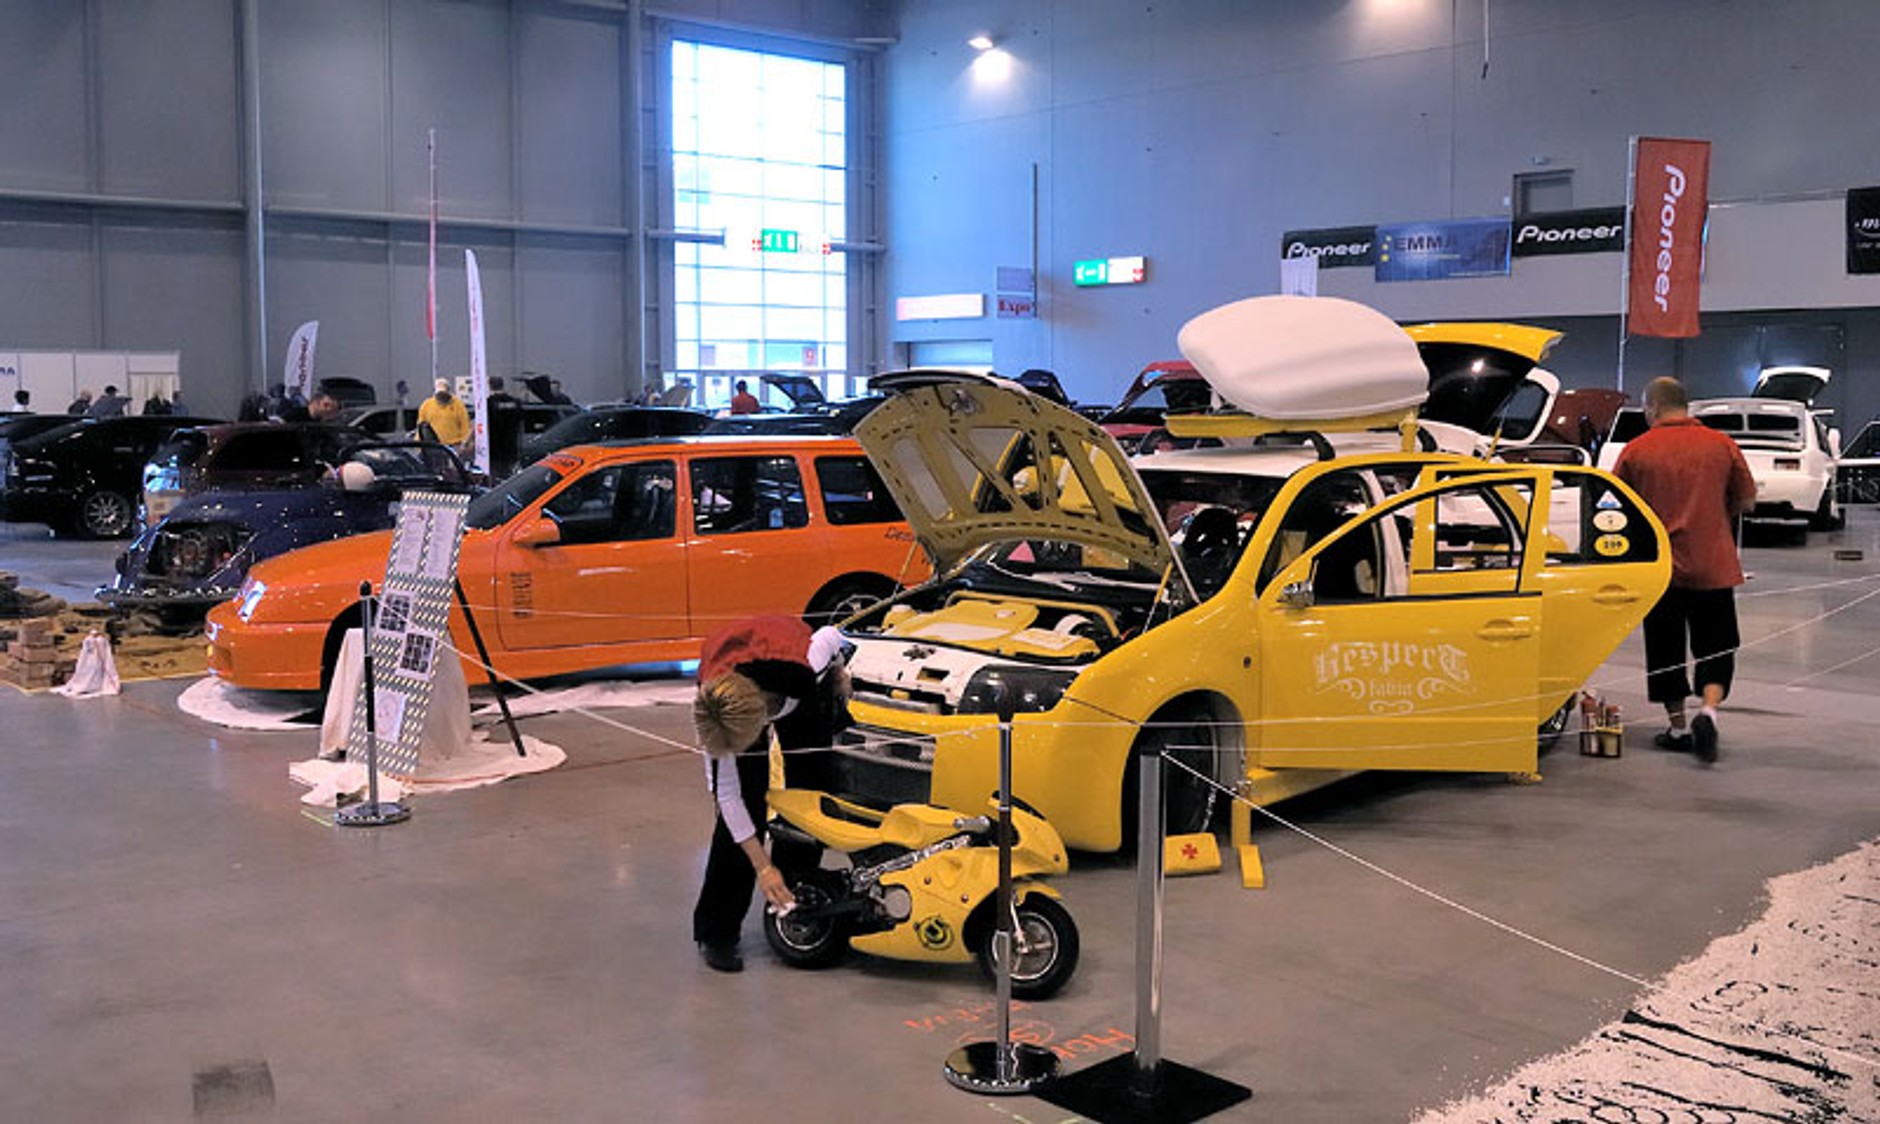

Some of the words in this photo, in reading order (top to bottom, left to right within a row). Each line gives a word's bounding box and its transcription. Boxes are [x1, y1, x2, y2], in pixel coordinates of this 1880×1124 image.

[1516, 224, 1622, 243] Pioneer
[1654, 164, 1686, 313] Pioneer
[1287, 241, 1371, 258] Pioneer
